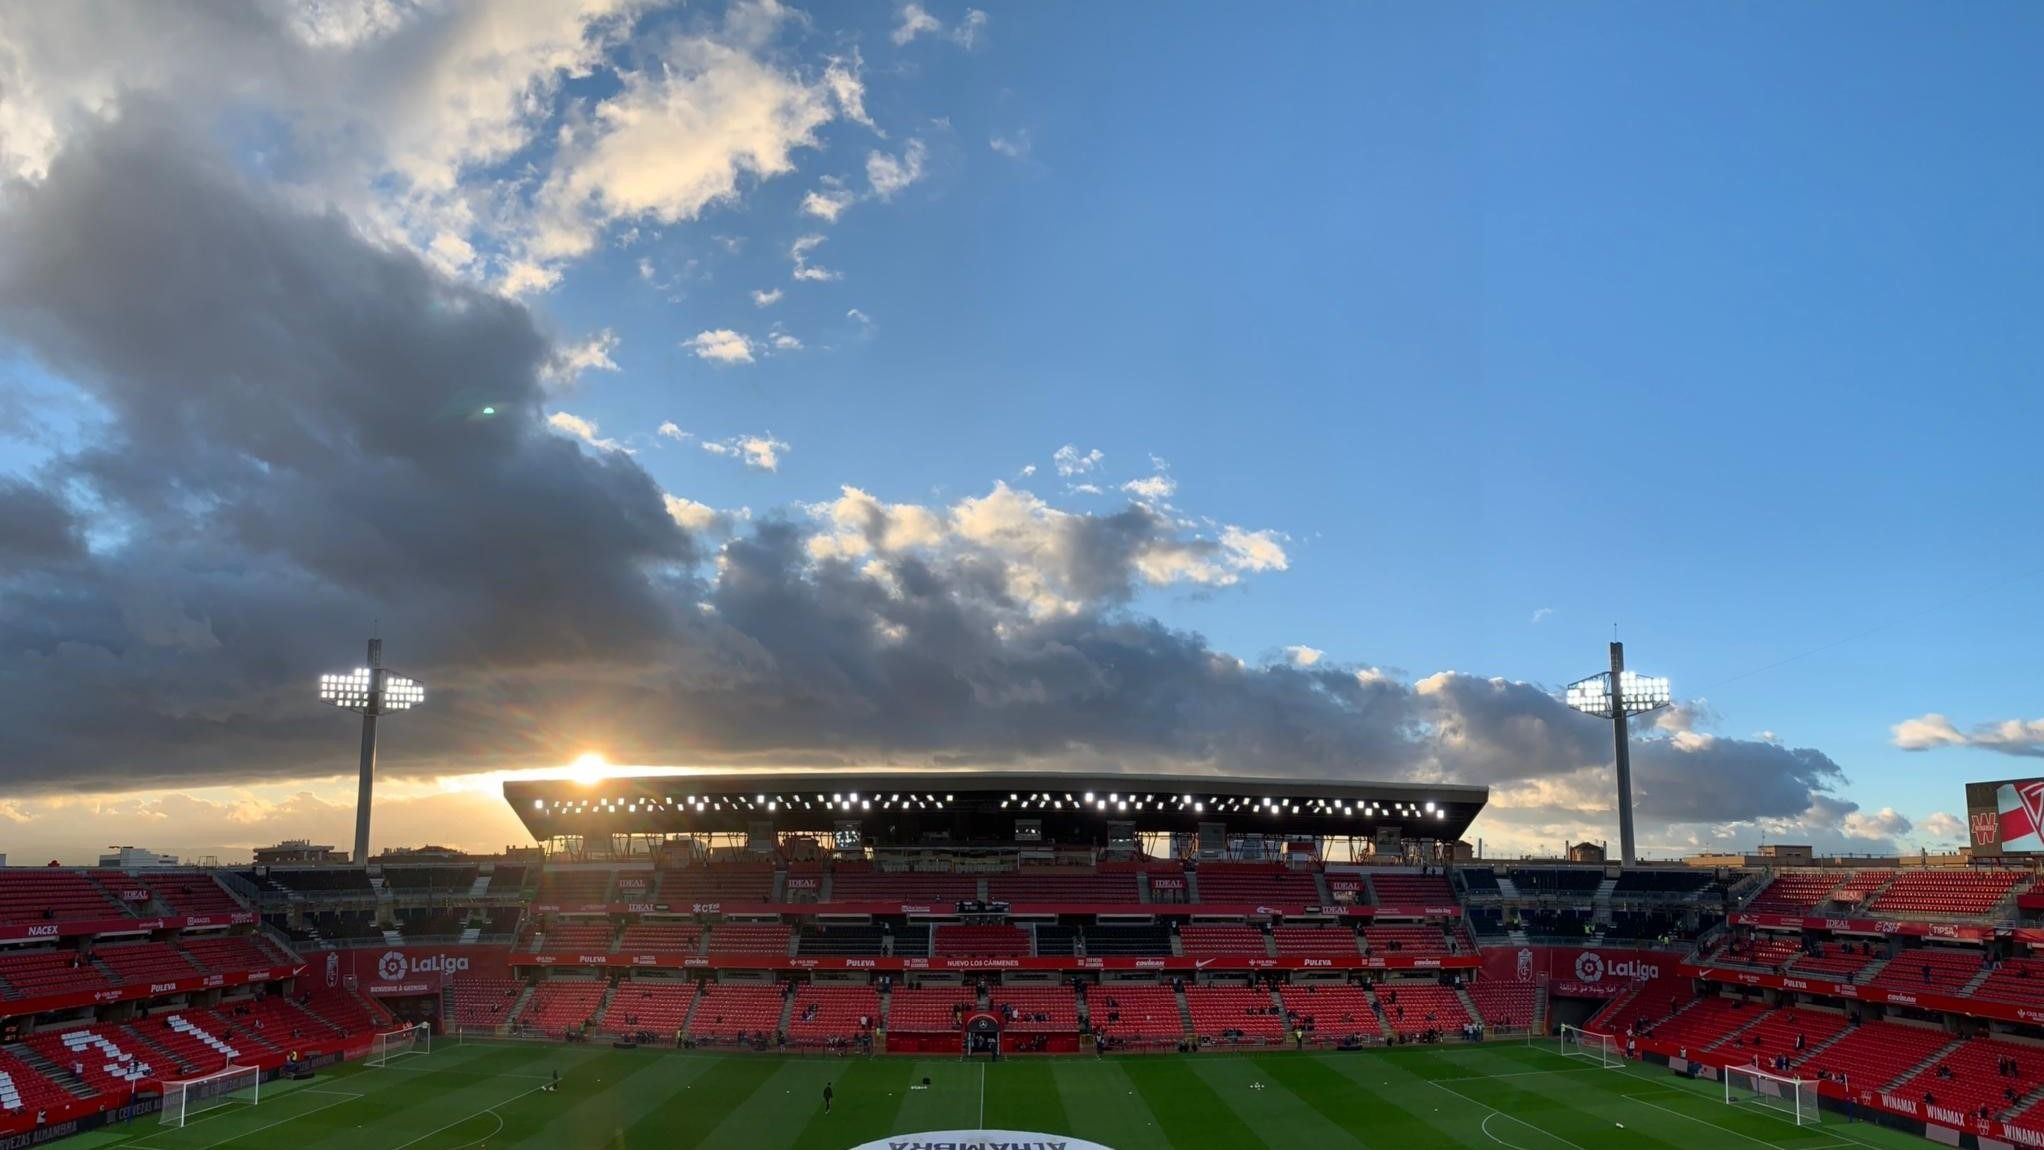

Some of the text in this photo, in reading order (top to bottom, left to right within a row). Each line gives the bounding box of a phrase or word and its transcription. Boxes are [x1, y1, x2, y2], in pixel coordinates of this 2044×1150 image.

[788, 879, 816, 888] IDEAL
[1155, 879, 1183, 888] IDEAL
[1333, 882, 1360, 890] IDEAL
[628, 903, 655, 911] IDEAL
[1321, 906, 1349, 914] IDEAL
[1825, 919, 1850, 929] IDEAL
[28, 925, 58, 935] NACEX
[1933, 925, 1954, 935] TIPSA
[579, 955, 606, 963] PULEVA
[846, 959, 875, 967] PULEVA
[983, 959, 1019, 967] CÁRMENES
[1304, 958, 1332, 966] PULEVA
[411, 954, 469, 975] LaLiga
[1607, 959, 1659, 981] LaLiga
[151, 982, 176, 992] PULEVA
[1783, 977, 1807, 989] PULEVA
[1881, 1094, 1917, 1115] WINAMAX
[1926, 1104, 1965, 1127] WINAMAX
